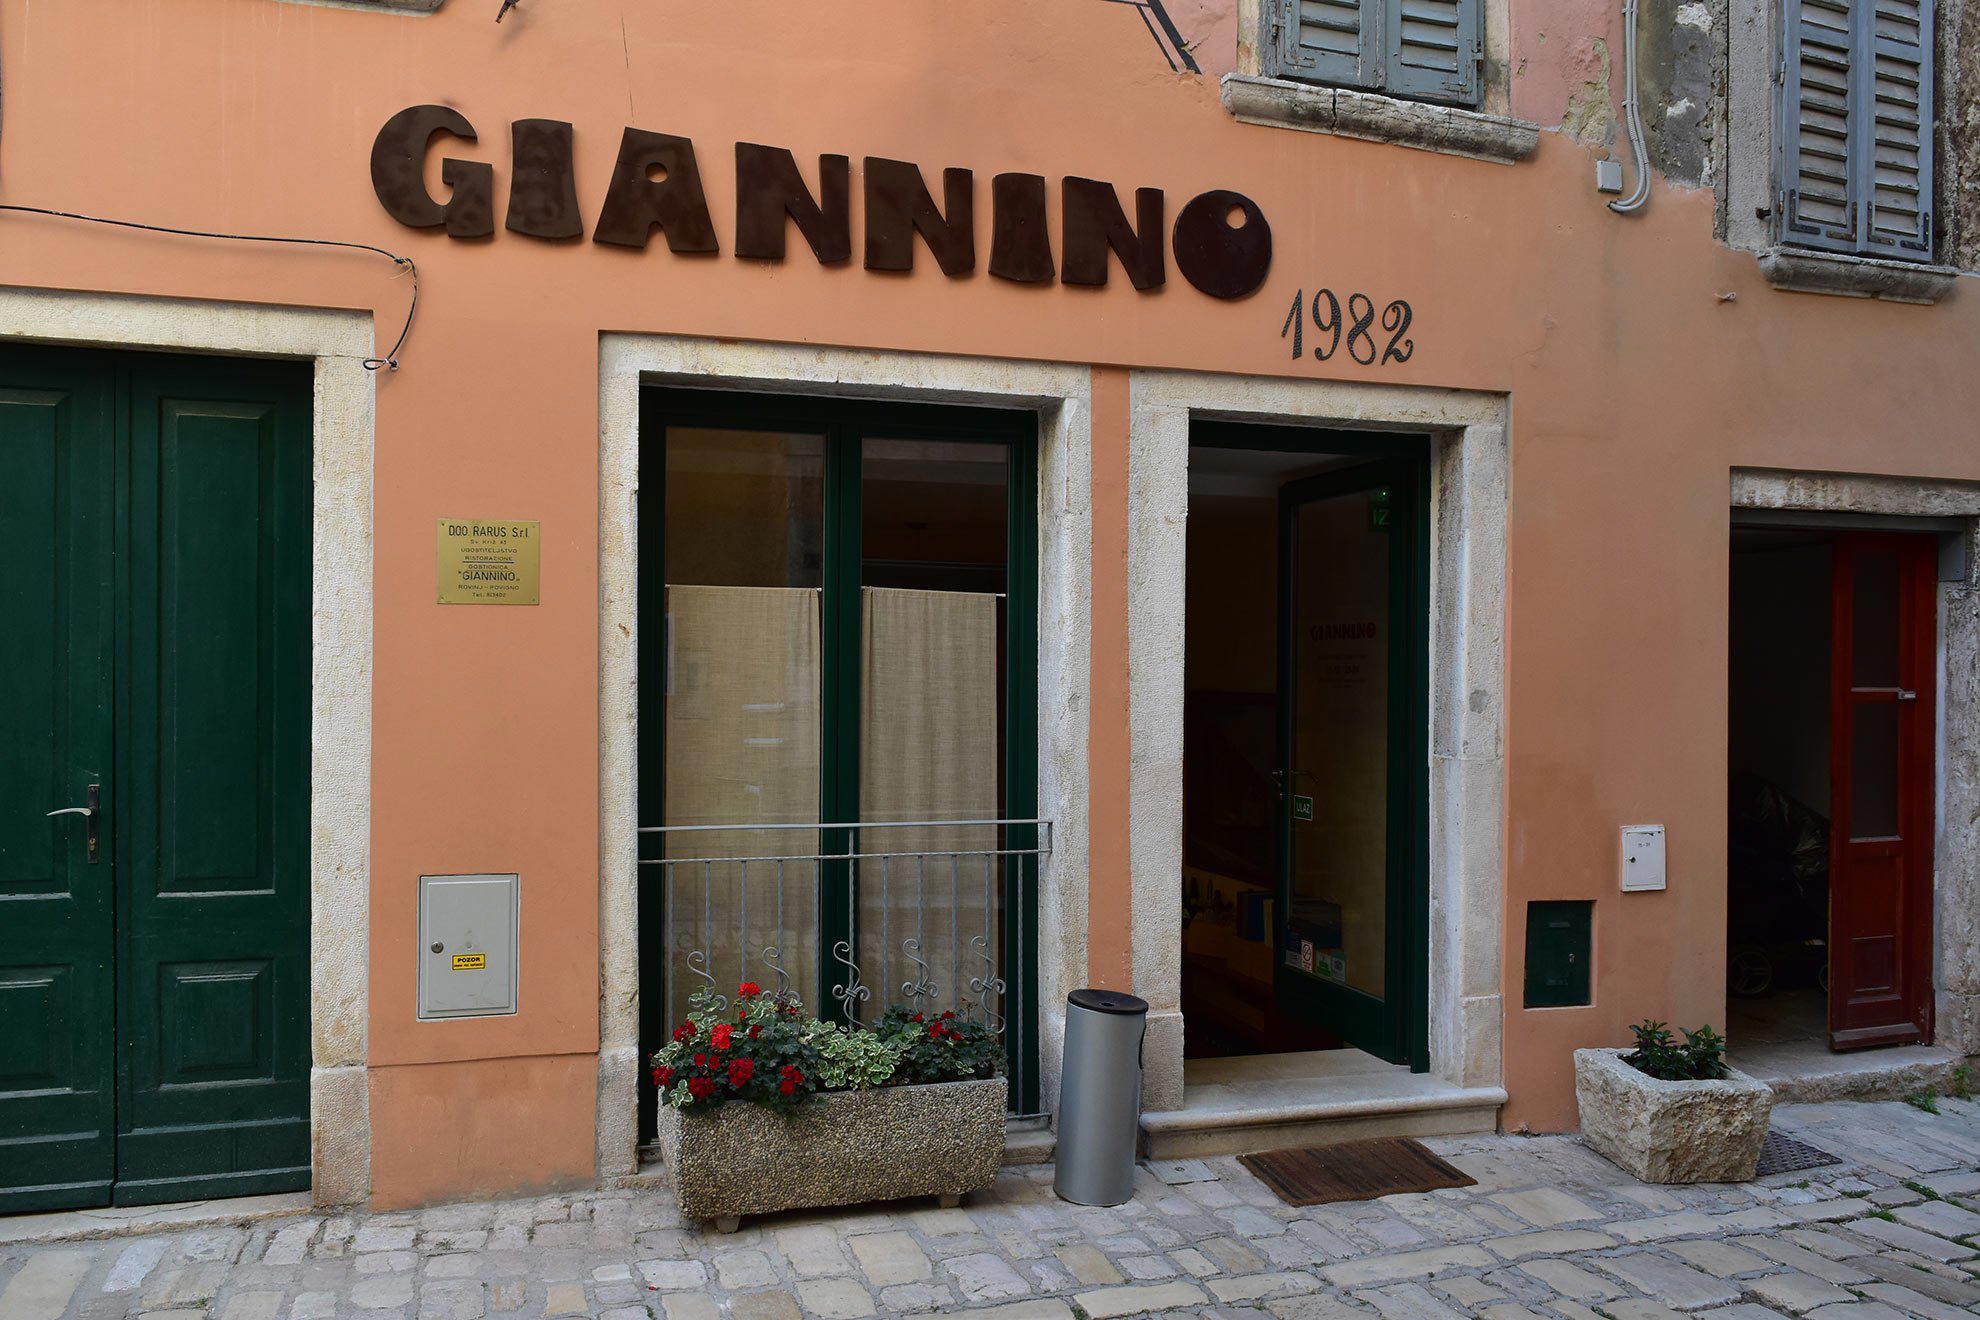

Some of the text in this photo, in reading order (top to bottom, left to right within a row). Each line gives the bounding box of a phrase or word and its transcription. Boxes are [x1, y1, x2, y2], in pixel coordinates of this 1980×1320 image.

[370, 104, 1272, 301] GIANNINO
[1281, 288, 1415, 367] 1982
[473, 526, 507, 537] RARUS
